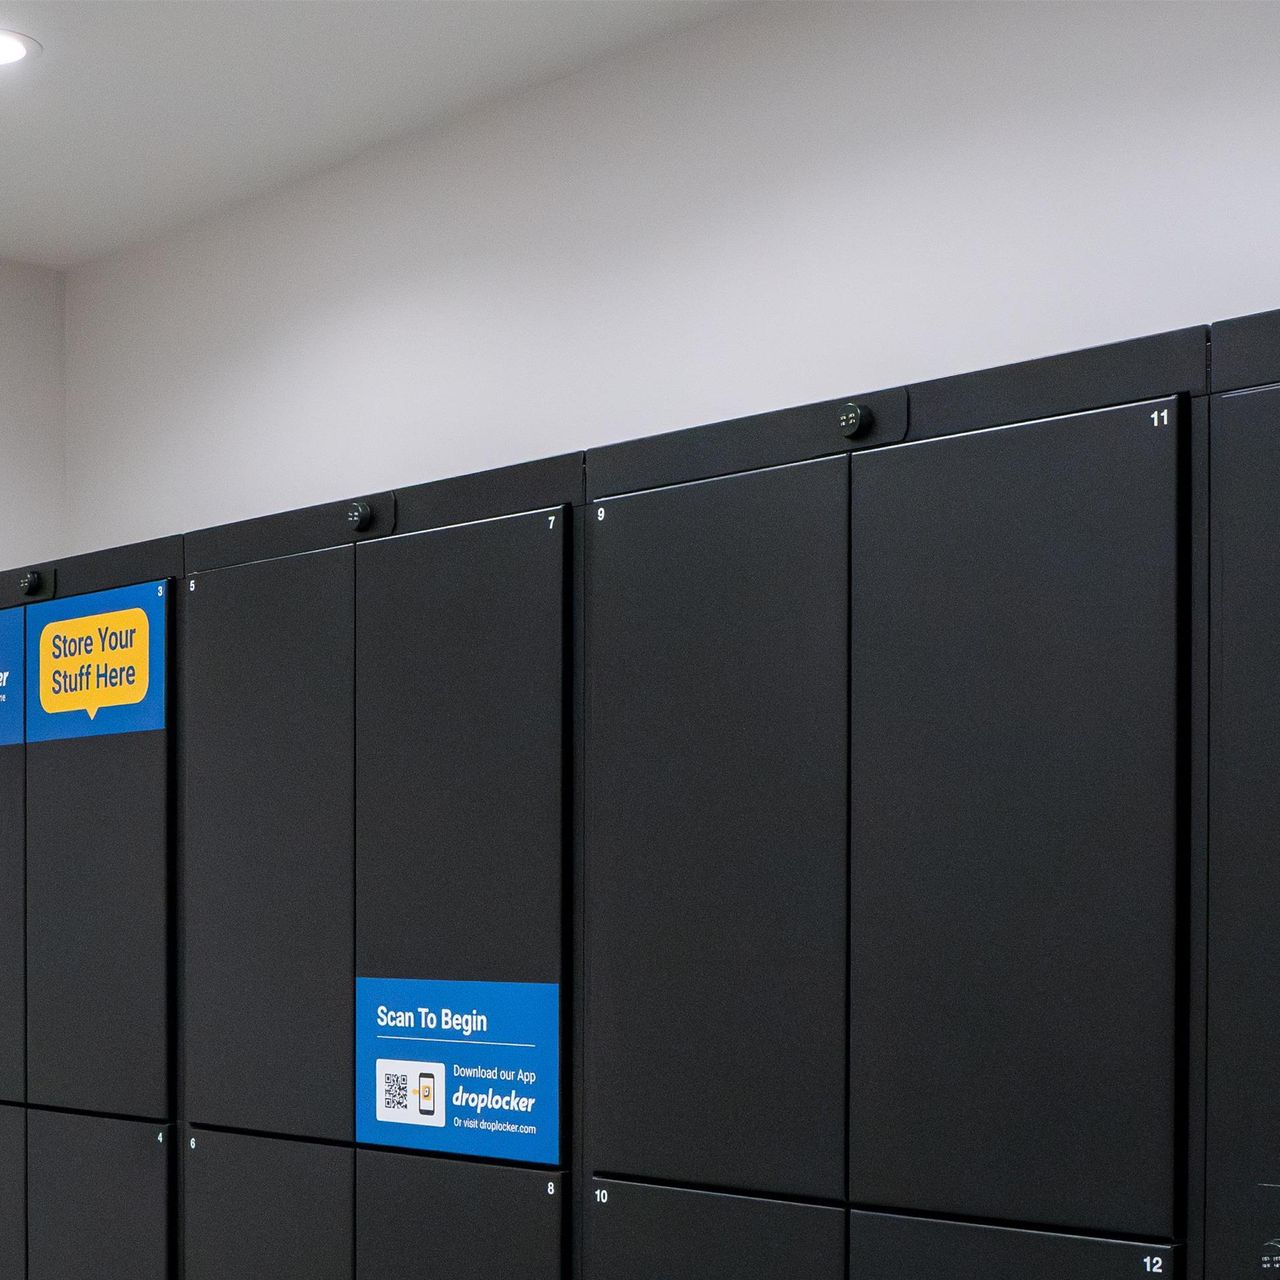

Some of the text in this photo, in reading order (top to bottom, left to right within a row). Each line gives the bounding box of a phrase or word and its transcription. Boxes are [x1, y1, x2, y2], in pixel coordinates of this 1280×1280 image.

[1150, 408, 1168, 427] 11
[597, 507, 605, 521] 9
[548, 515, 556, 530] 7
[157, 585, 163, 597] 3
[189, 580, 195, 592] 5
[51, 626, 136, 659] Store Your
[51, 663, 136, 694] Stuff Here
[376, 1005, 488, 1036] Scan To Begin
[453, 1064, 536, 1085] Download our App
[452, 1085, 536, 1114] droplocker
[453, 1117, 536, 1134] Or visit droplocker.com
[157, 1132, 163, 1143] 4
[190, 1137, 196, 1149] 6
[547, 1182, 555, 1195] 8
[594, 1189, 608, 1203] 10
[1143, 1256, 1163, 1273] 12
